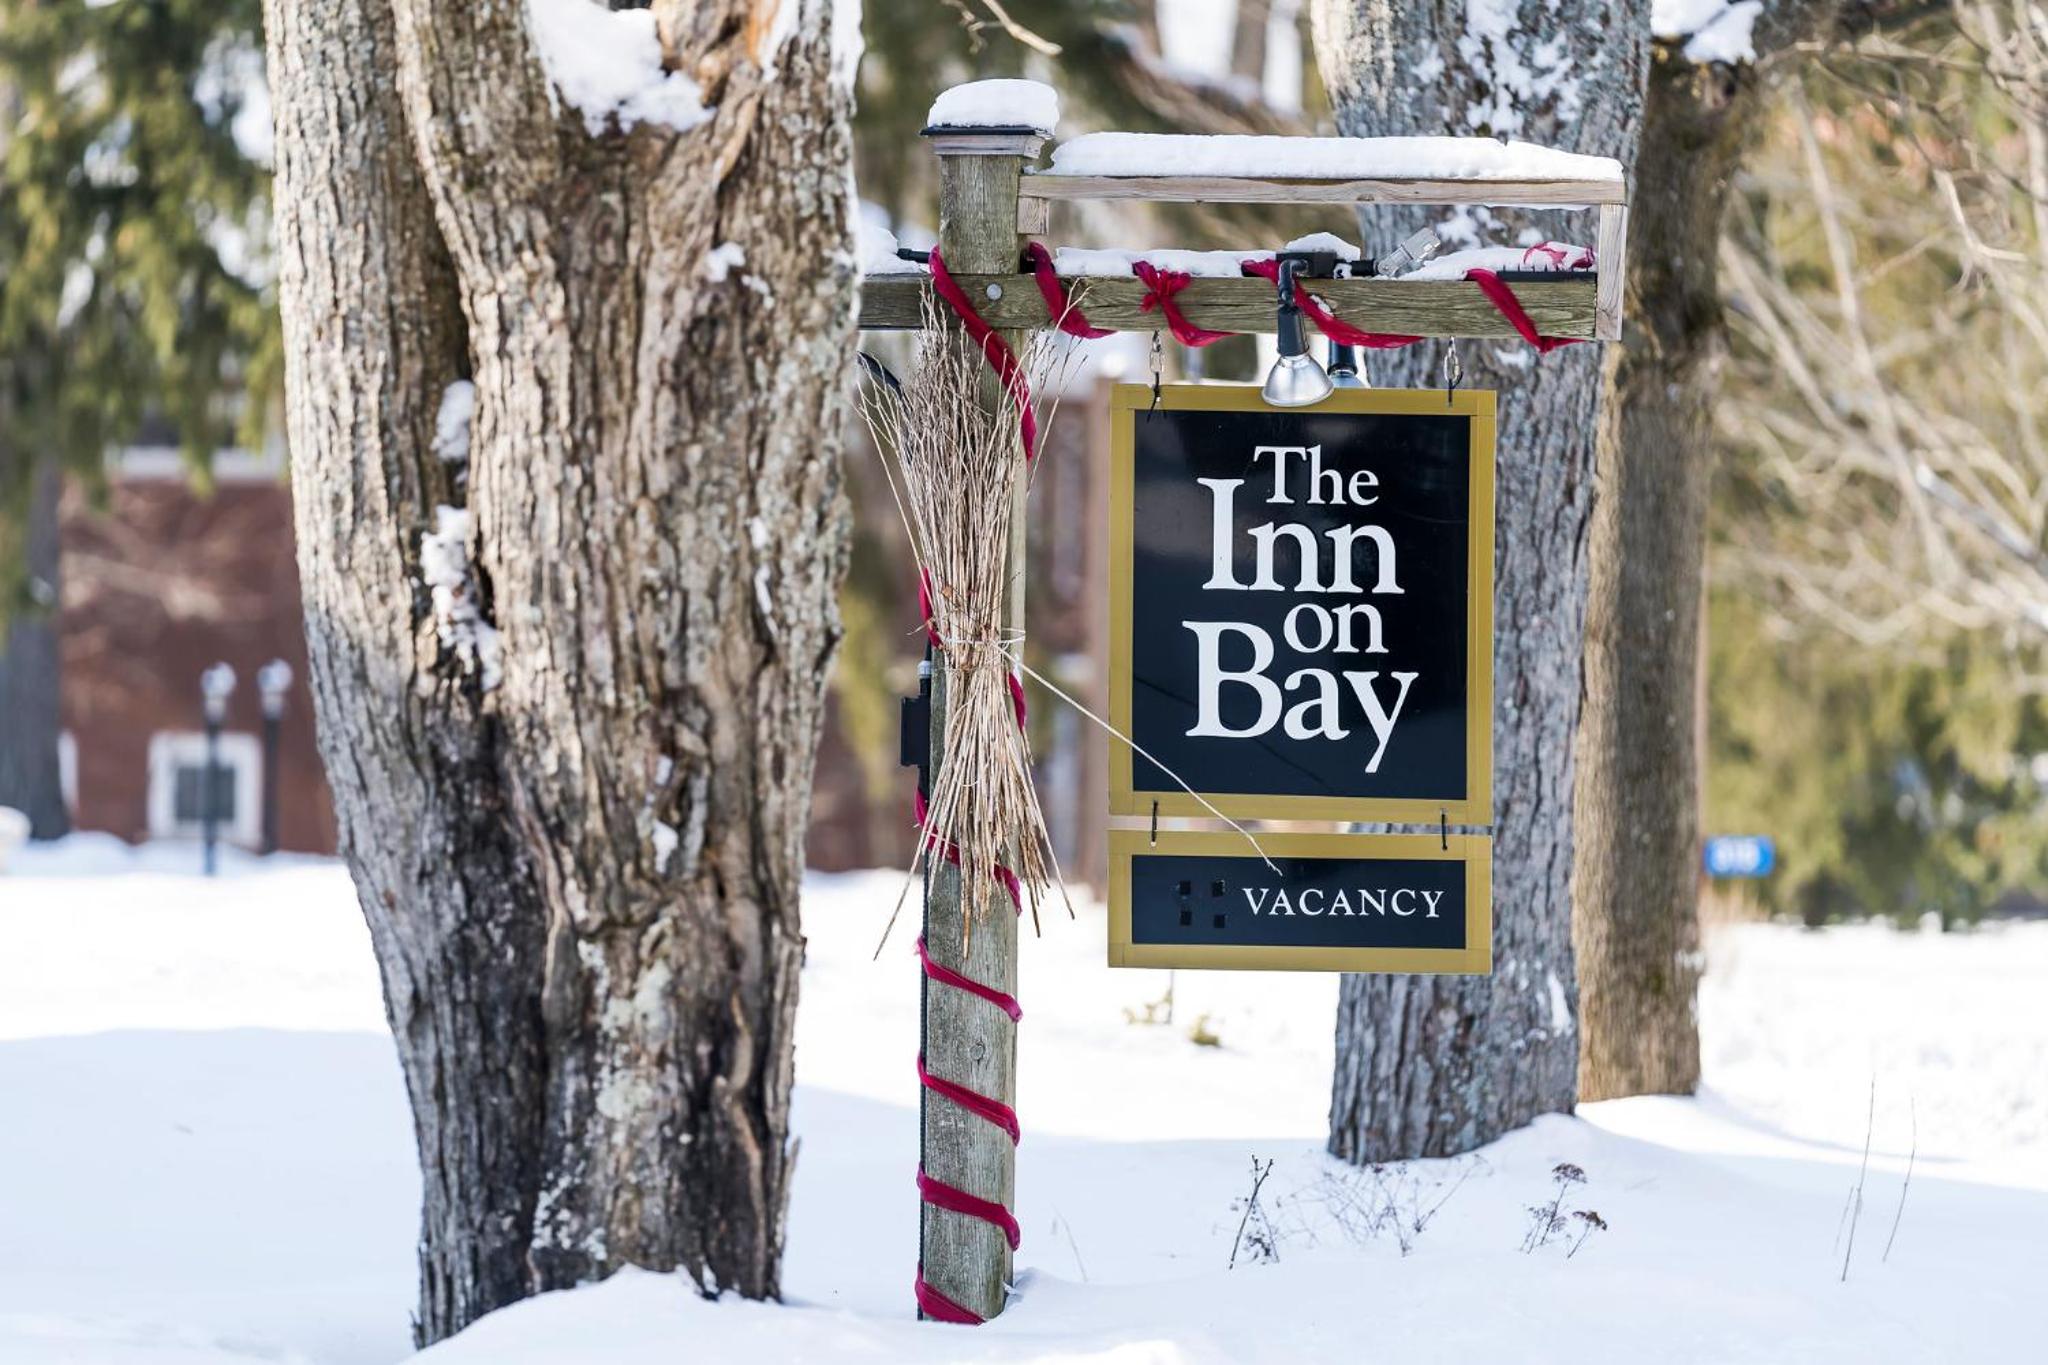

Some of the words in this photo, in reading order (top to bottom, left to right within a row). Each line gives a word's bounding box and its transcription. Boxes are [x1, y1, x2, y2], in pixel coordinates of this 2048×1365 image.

[1253, 445, 1379, 506] The
[1196, 477, 1405, 594] Inn
[1283, 602, 1389, 654] on
[1181, 620, 1420, 774] Bay
[1242, 887, 1444, 918] VACANCY
